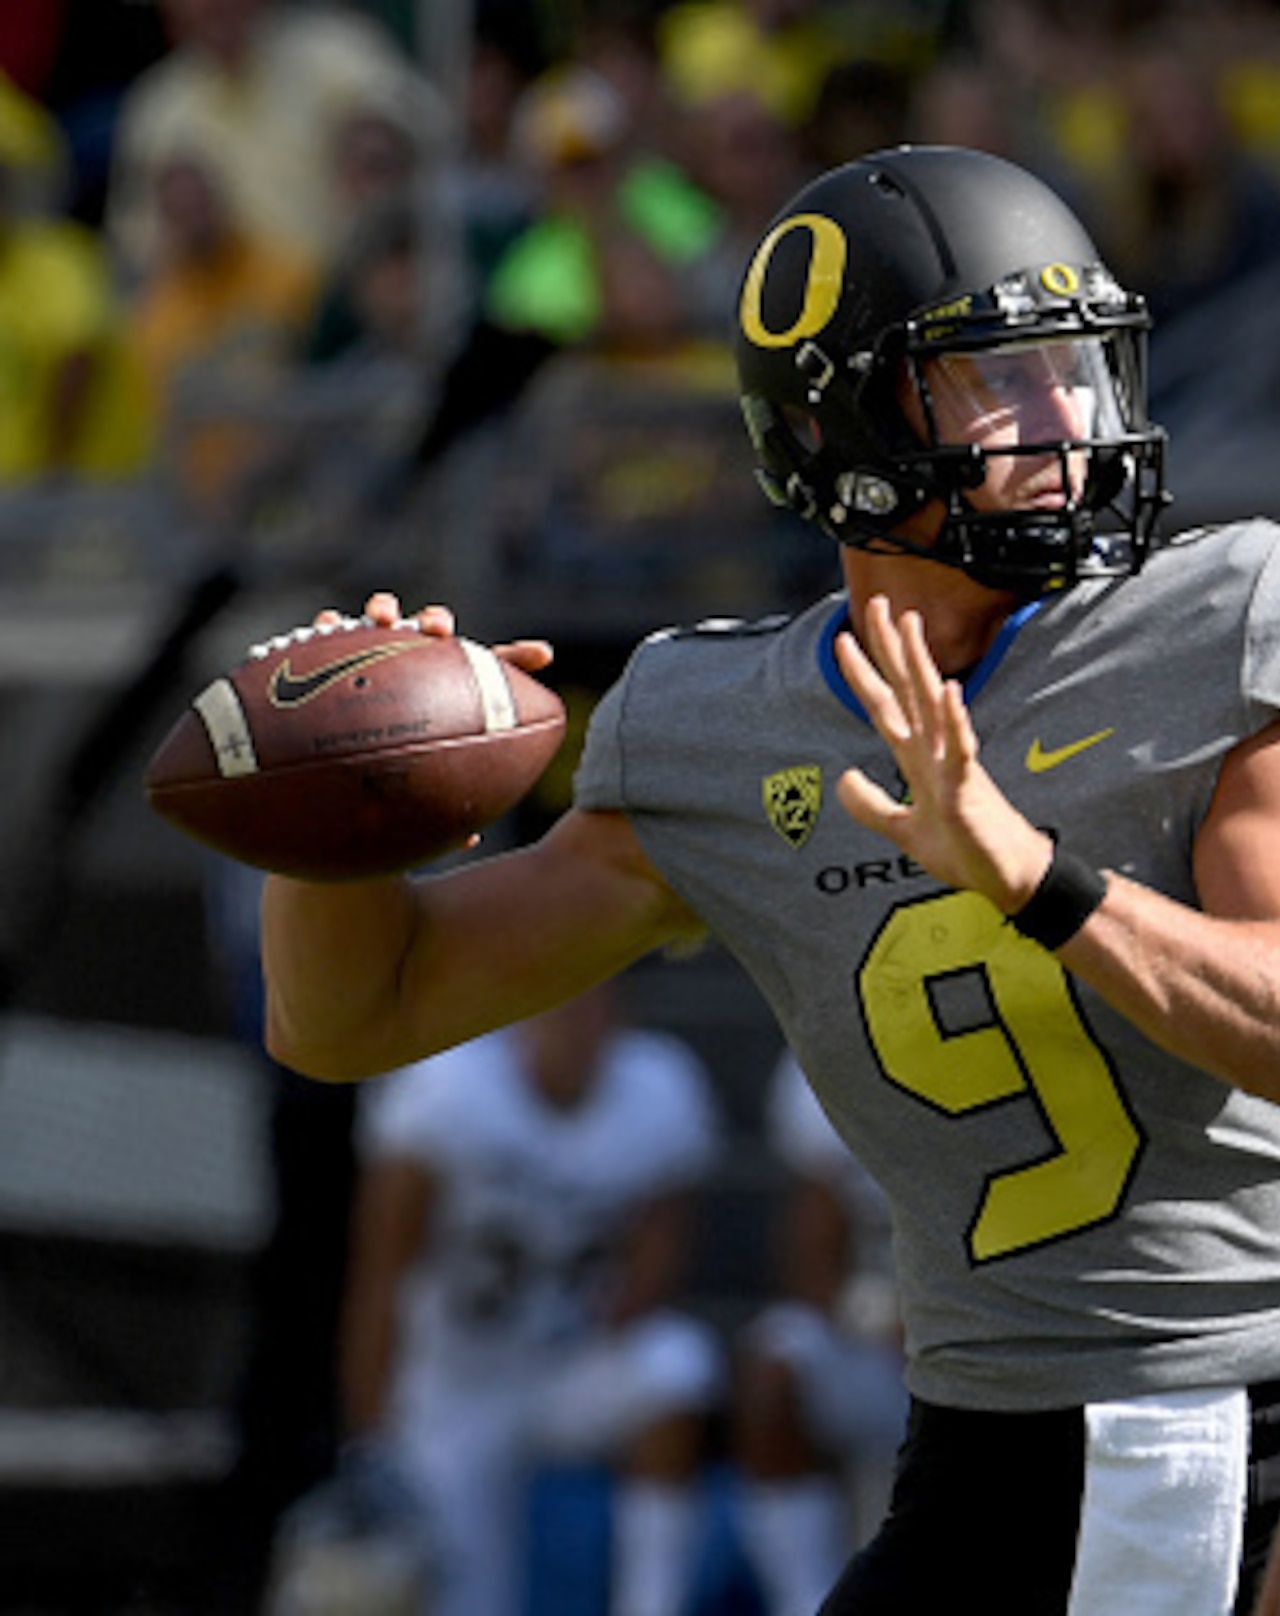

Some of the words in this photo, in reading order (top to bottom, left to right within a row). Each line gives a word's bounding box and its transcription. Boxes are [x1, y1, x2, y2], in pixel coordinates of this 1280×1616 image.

[740, 212, 848, 348] O
[815, 853, 927, 895] ORE
[854, 887, 1148, 1269] 9
